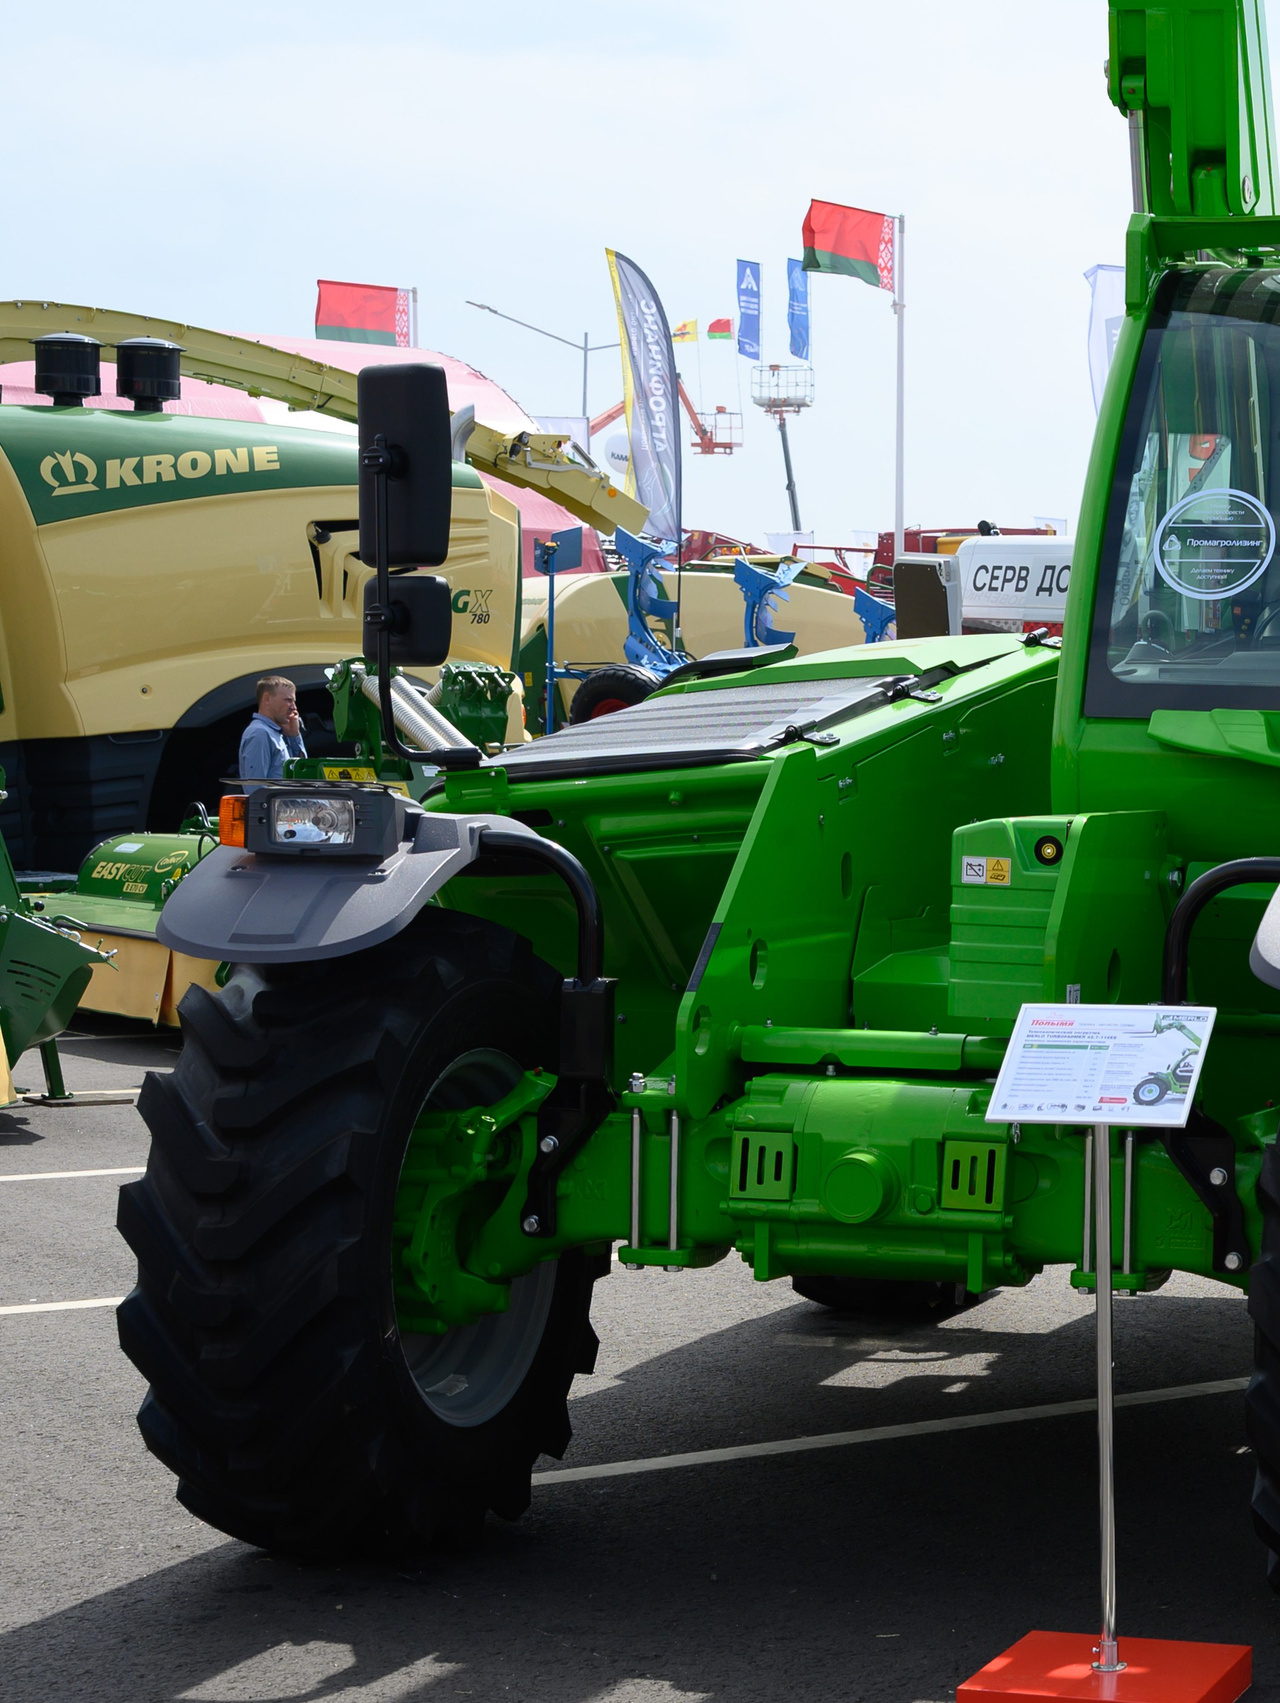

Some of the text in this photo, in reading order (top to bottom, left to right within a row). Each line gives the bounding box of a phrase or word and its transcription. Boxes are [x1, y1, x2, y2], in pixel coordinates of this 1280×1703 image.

[105, 445, 281, 490] KRONE
[1187, 538, 1263, 548] Промагролизинг
[972, 564, 1030, 593] СЕРВ
[470, 613, 491, 624] 780
[1030, 1019, 1075, 1027] Полымя
